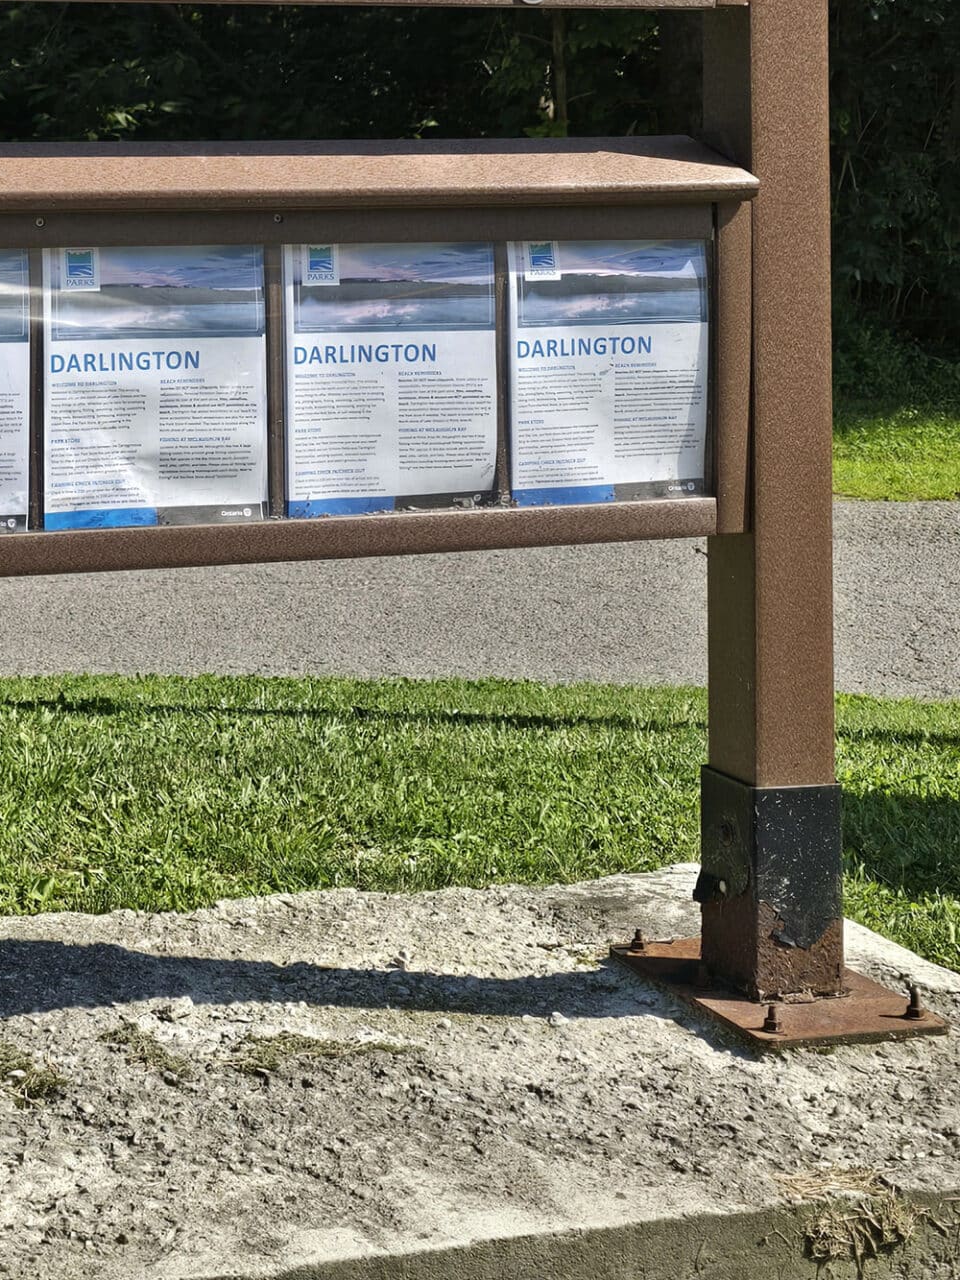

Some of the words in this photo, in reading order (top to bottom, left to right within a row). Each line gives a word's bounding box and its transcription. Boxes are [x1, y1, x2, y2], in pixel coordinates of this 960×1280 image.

[294, 344, 435, 364] DARLINGTON
[517, 336, 651, 358] DARLINGTON
[51, 350, 199, 373] DARLINGTON
